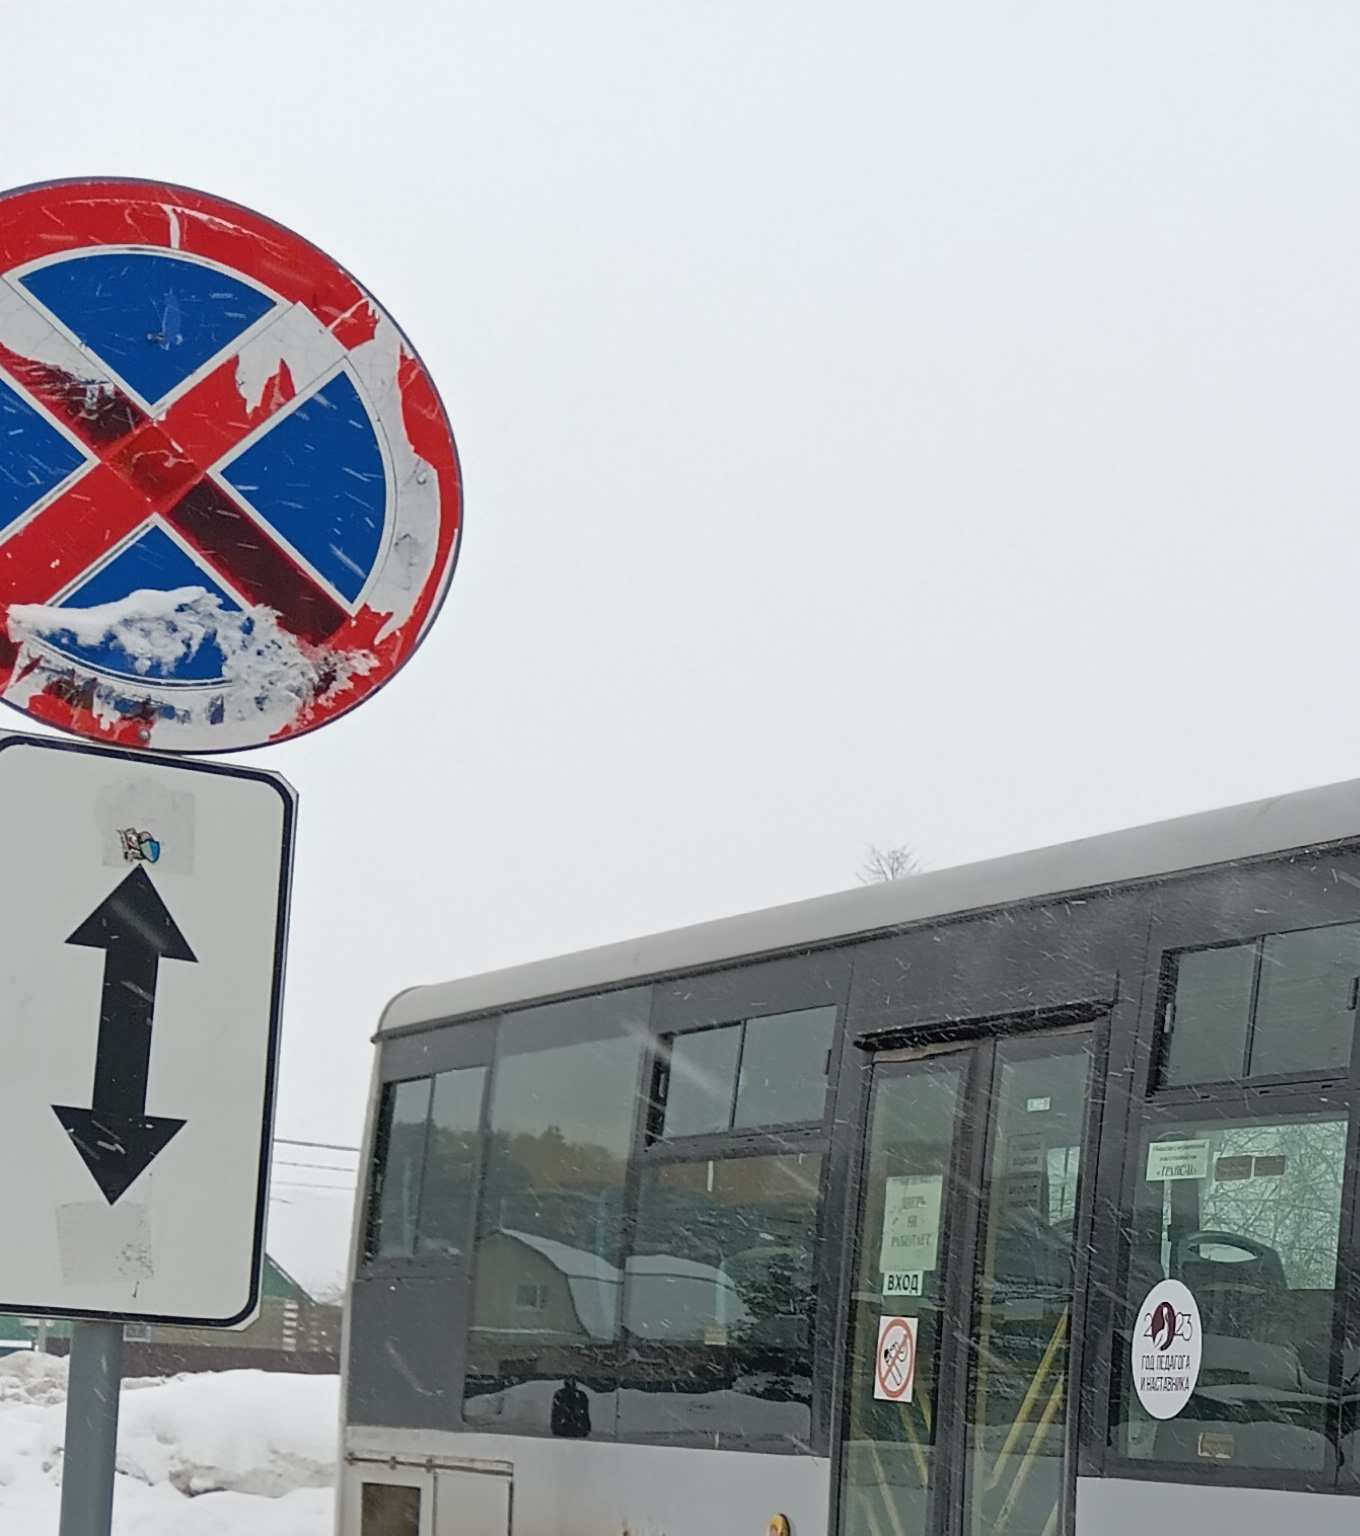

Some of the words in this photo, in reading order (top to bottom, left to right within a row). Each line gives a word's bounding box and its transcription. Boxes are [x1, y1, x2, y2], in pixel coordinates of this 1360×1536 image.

[887, 1274, 919, 1294] ВХОД
[1143, 1302, 1193, 1351] 2023
[1141, 1355, 1155, 1371] ГОД
[1156, 1354, 1191, 1371] ПЕДАГОГА
